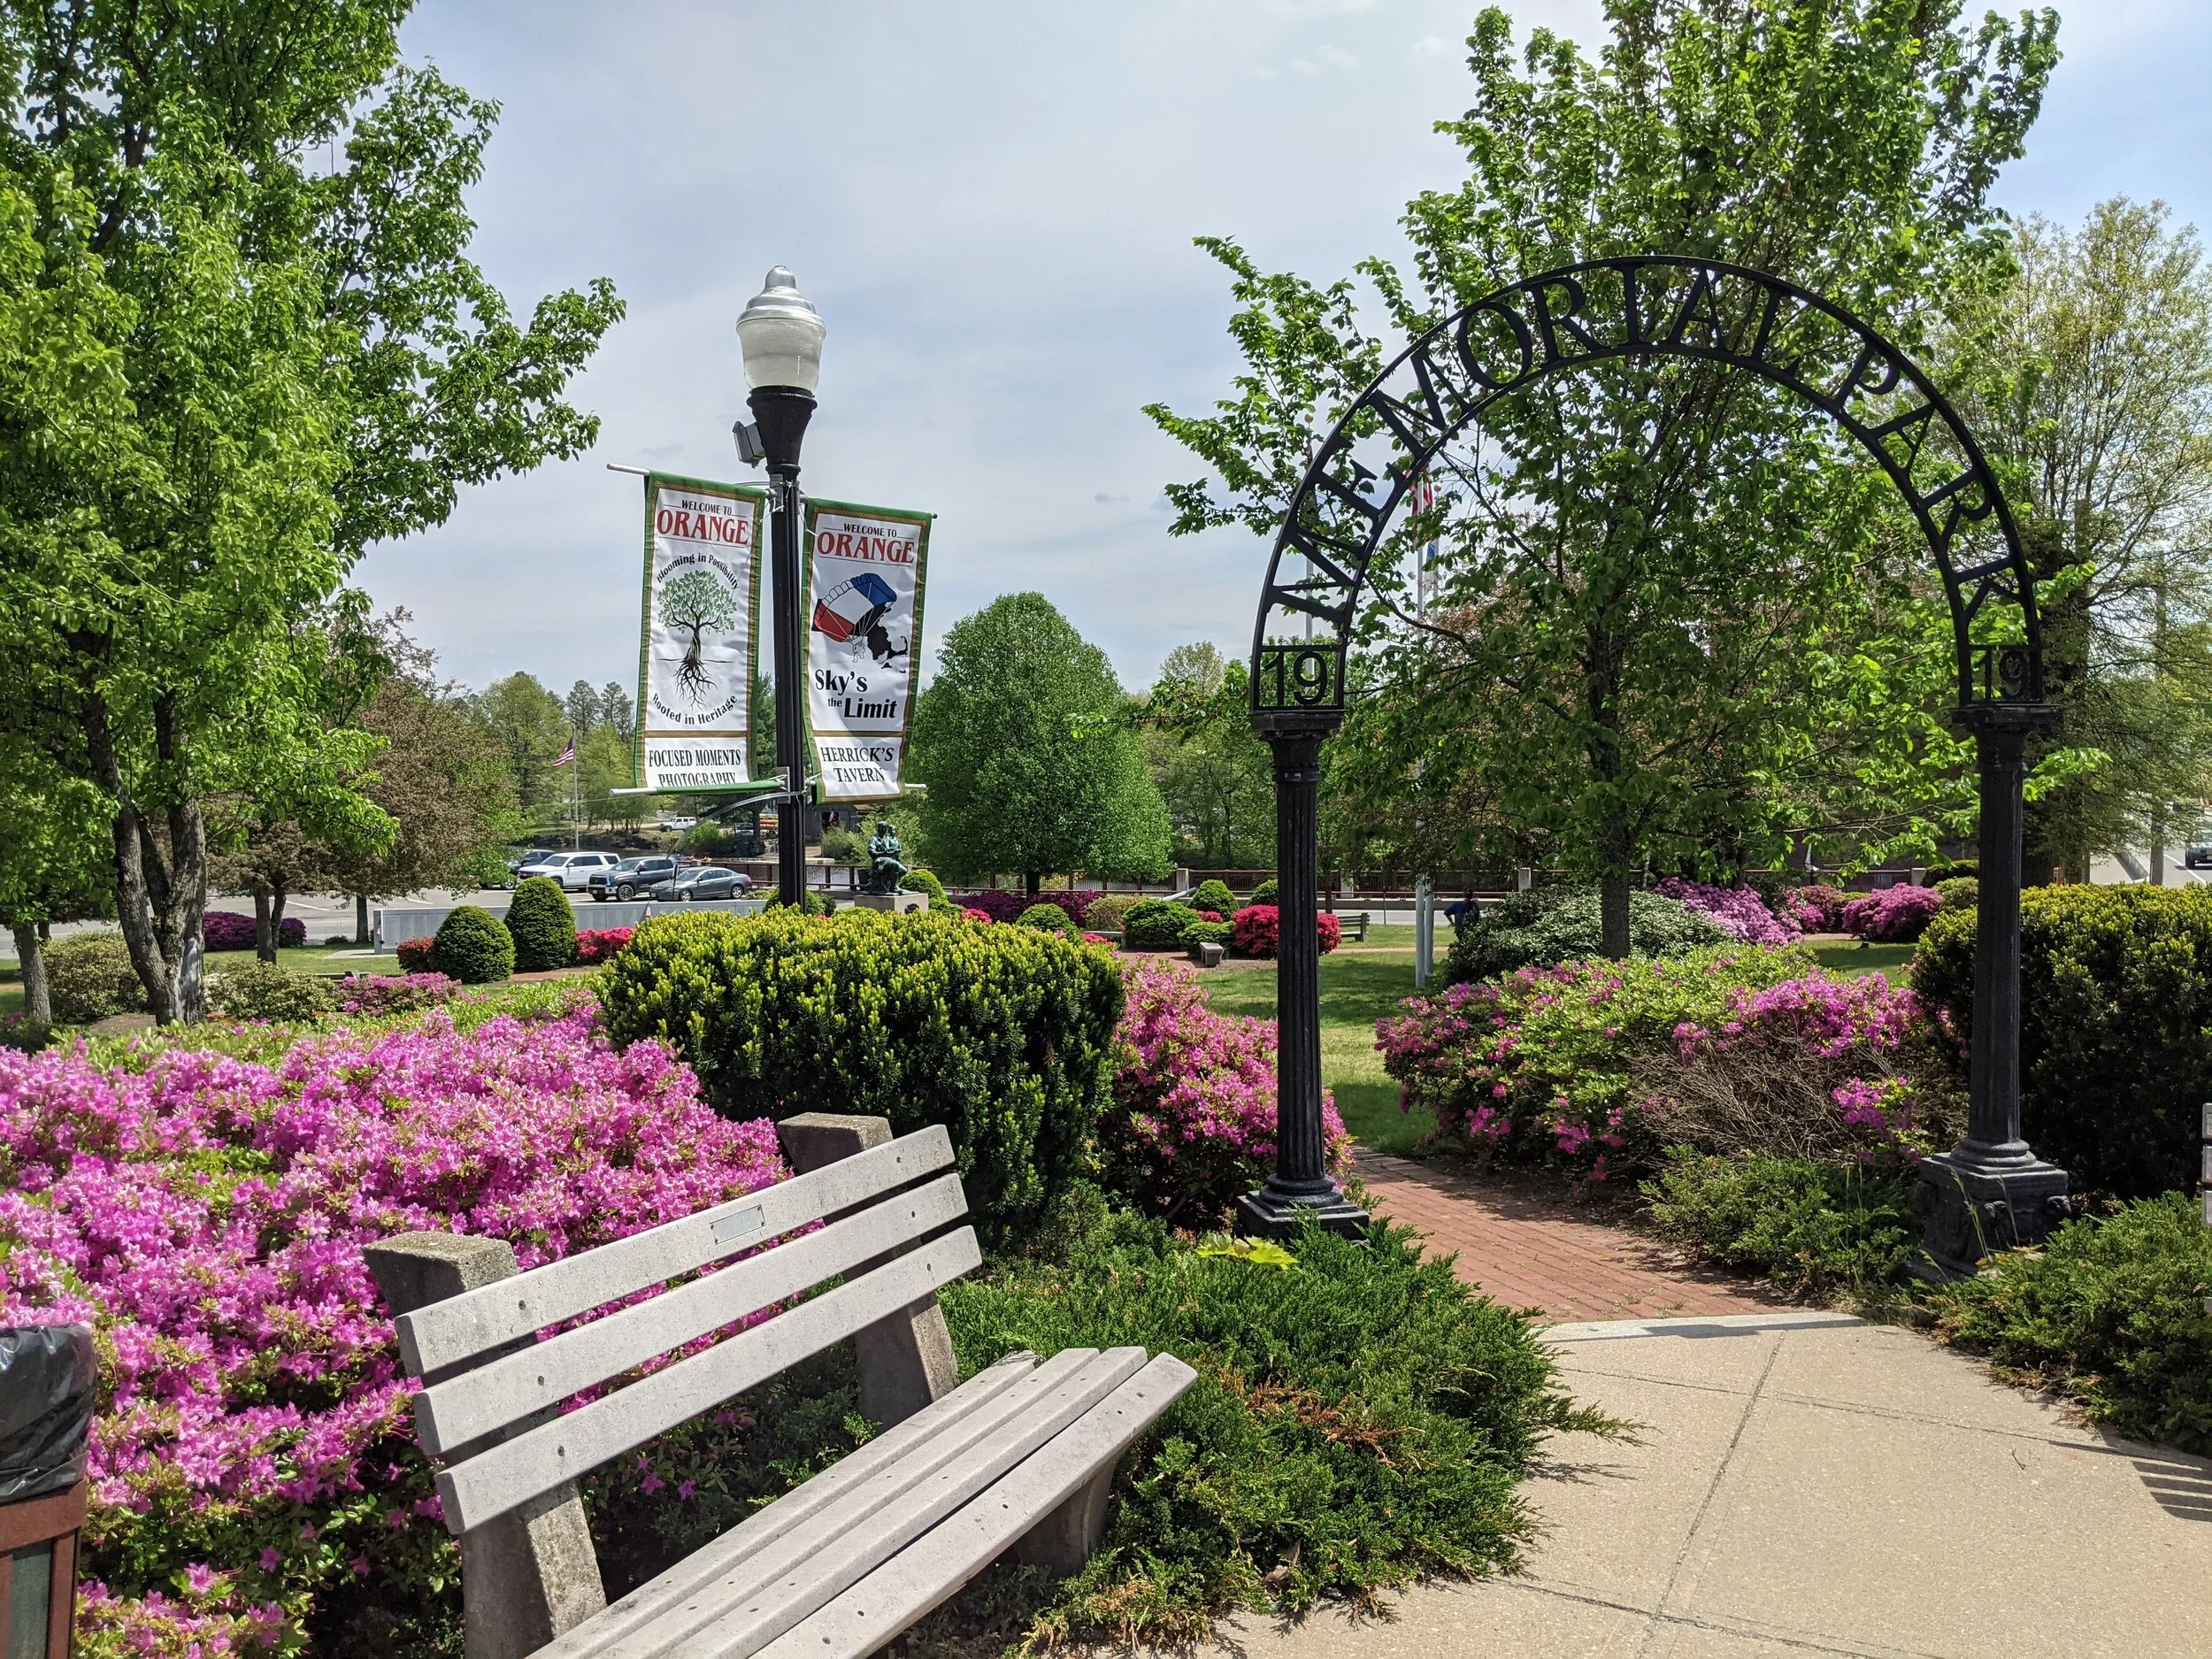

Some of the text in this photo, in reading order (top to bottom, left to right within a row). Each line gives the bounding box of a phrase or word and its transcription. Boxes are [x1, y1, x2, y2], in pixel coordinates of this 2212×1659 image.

[1265, 262, 2028, 630] MEMORIAL PARK
[681, 499, 733, 517] WELCOME TO
[657, 509, 749, 545] ORANGE
[843, 523, 897, 538] WELCOME TO
[817, 531, 916, 565] ORANGE
[657, 553, 740, 590] Blooming in Possibility
[815, 669, 868, 695] Sky's
[1263, 650, 1327, 706] 19
[1971, 649, 2028, 700] 19
[652, 692, 738, 725] Rooted in Heritage
[827, 697, 897, 718] the Limit
[649, 749, 741, 767] FOCUSED MOMENTS
[820, 747, 895, 763] HERRICK'S
[658, 772, 736, 787] PHOTOGRAPHY
[833, 767, 886, 783] TAVERN
